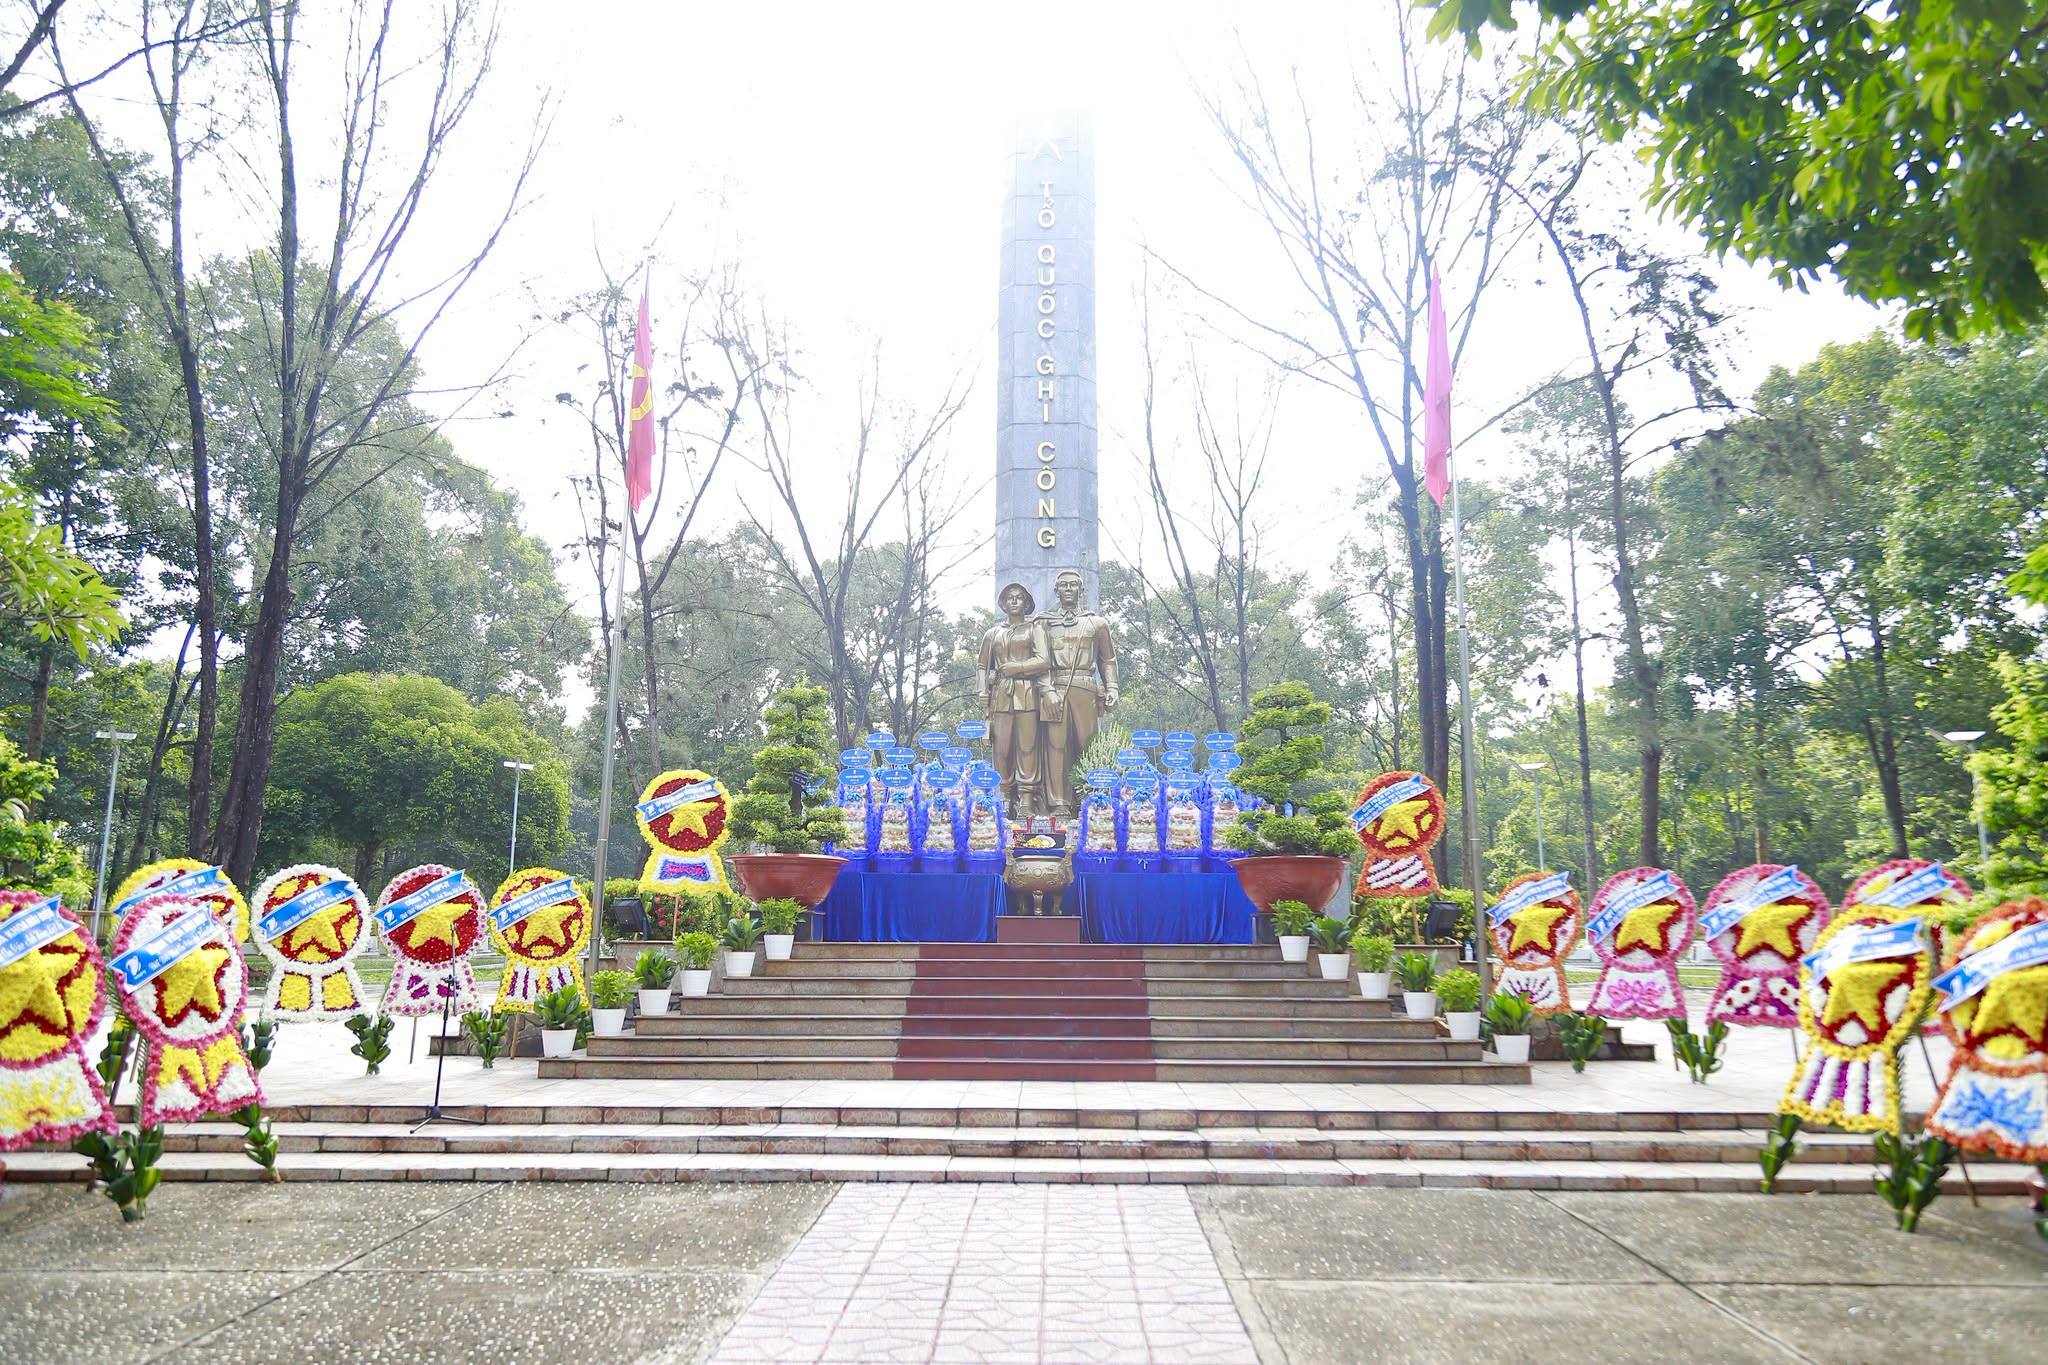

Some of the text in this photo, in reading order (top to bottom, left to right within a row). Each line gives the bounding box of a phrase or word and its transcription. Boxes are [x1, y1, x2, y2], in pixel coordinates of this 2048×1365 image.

[1036, 183, 1057, 549] TỔ QUỐC GHI CÔNG
